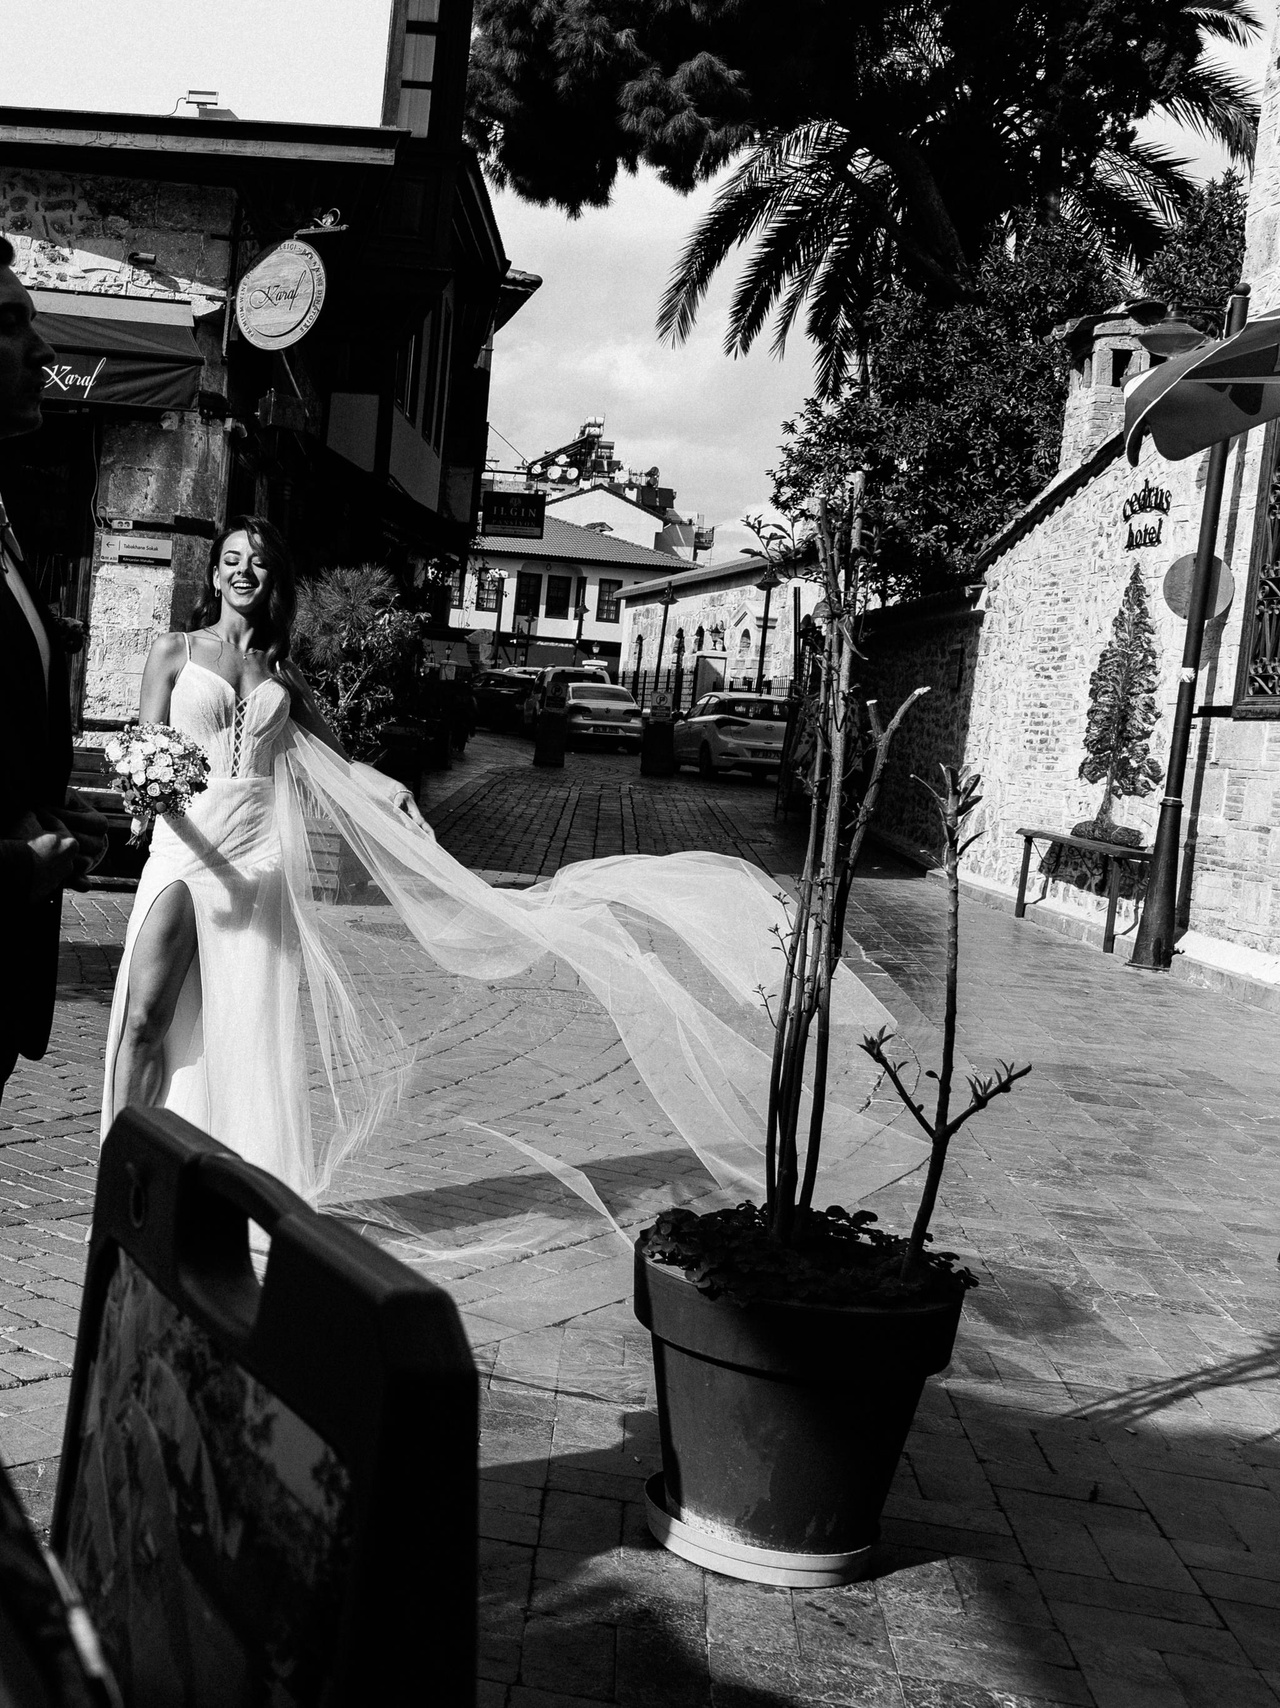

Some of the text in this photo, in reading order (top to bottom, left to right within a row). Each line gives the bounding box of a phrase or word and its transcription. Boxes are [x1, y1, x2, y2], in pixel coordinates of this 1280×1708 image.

[249, 270, 306, 311] Karaf
[239, 306, 255, 338] PREMIUM
[493, 506, 537, 518] ILGIN
[1124, 518, 1164, 552] hotel
